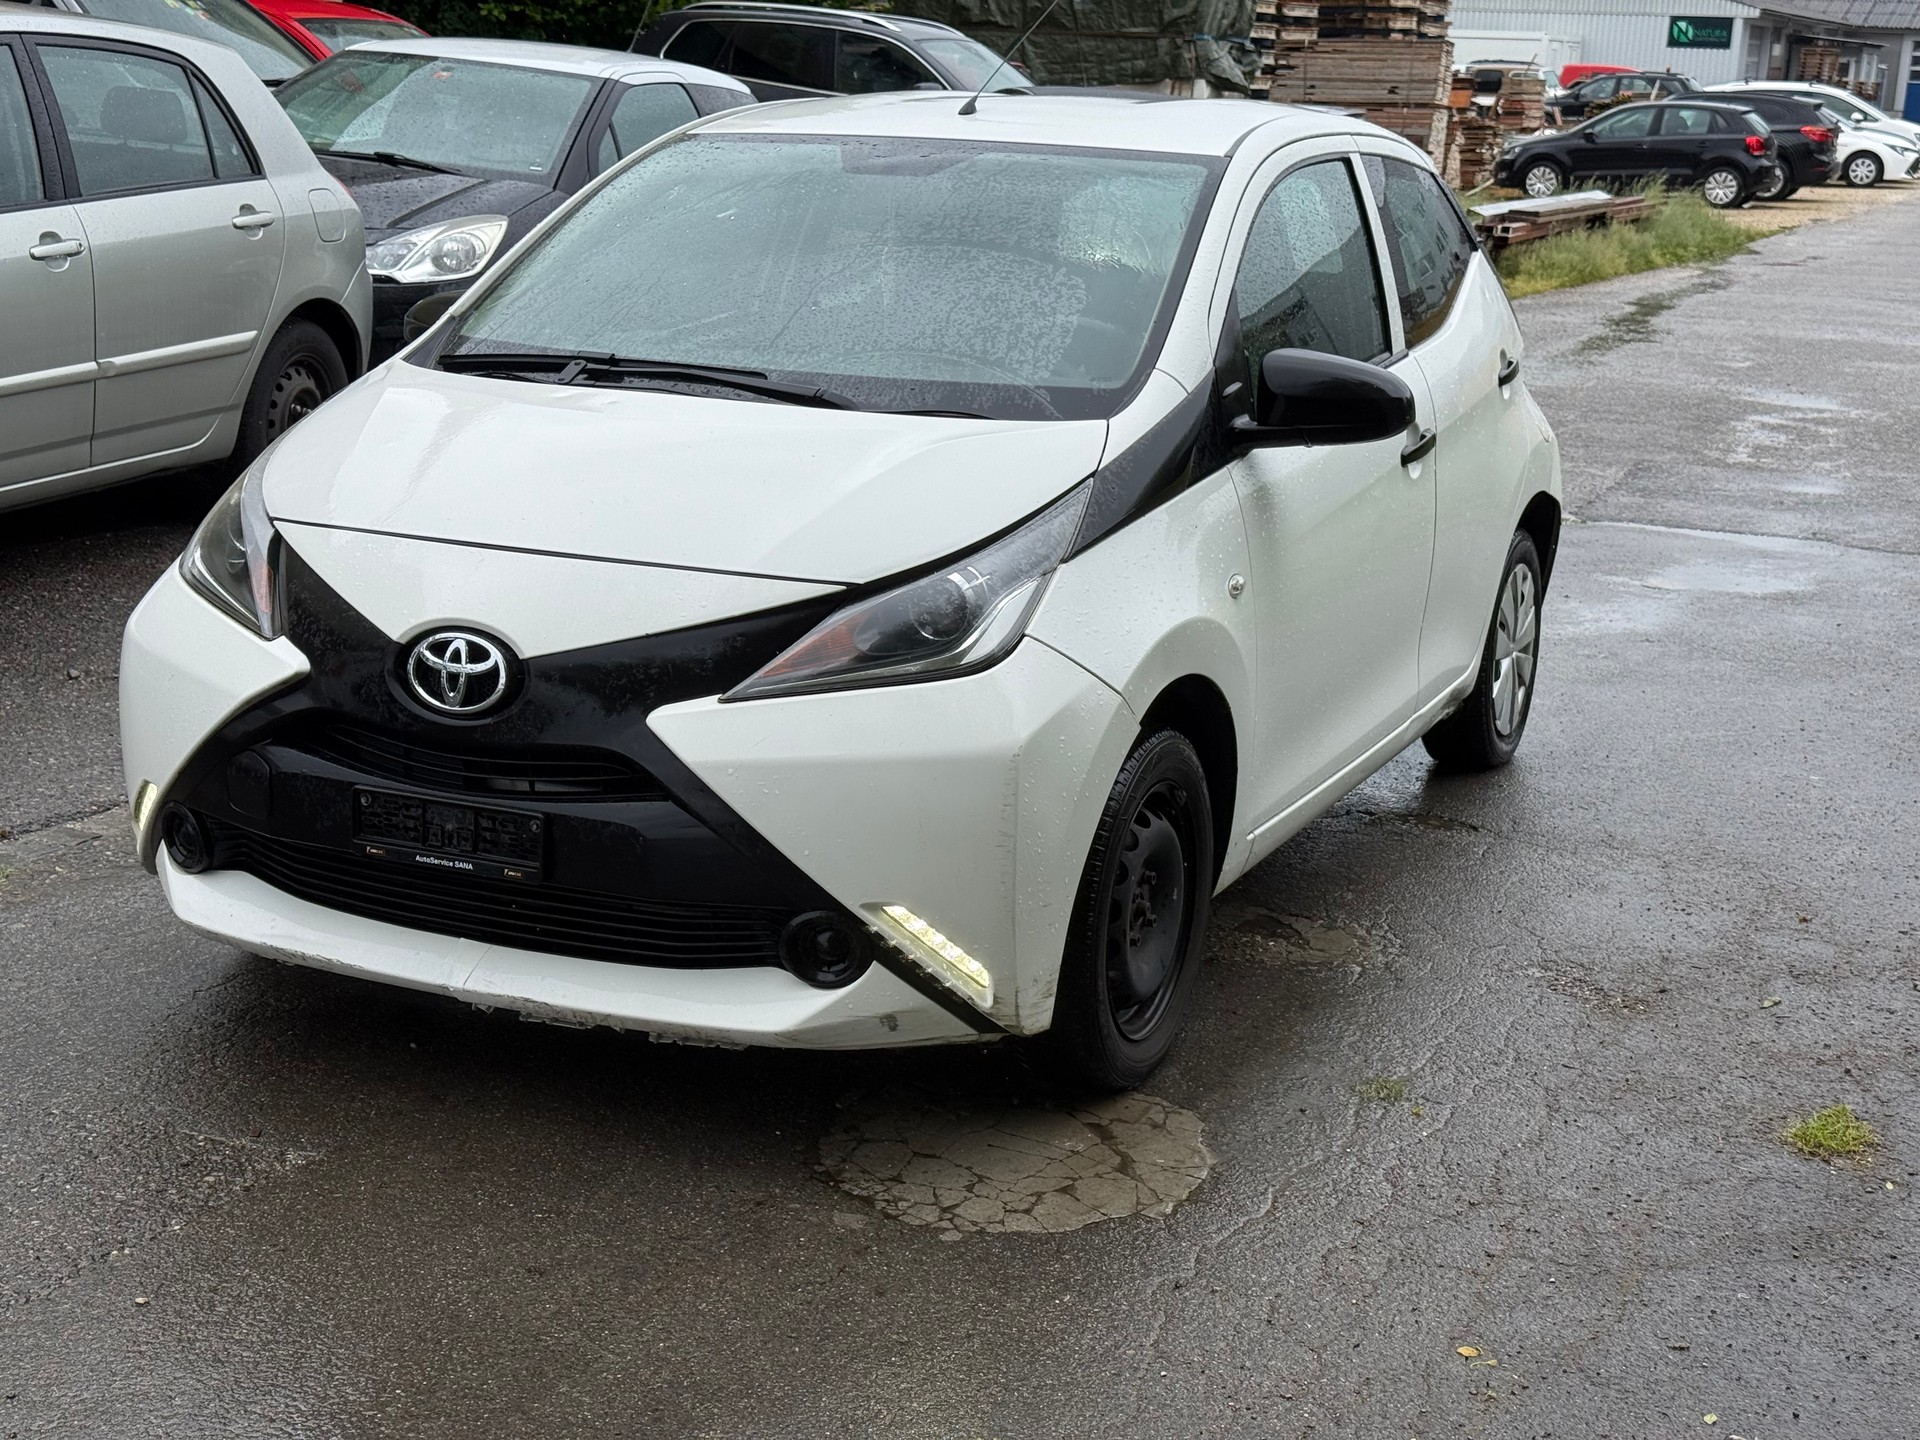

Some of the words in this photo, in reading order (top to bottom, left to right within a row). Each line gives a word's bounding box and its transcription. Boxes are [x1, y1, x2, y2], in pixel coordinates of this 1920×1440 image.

[1694, 29, 1728, 38] NATURA
[415, 854, 453, 867] AutoService
[454, 860, 474, 871] SANA
